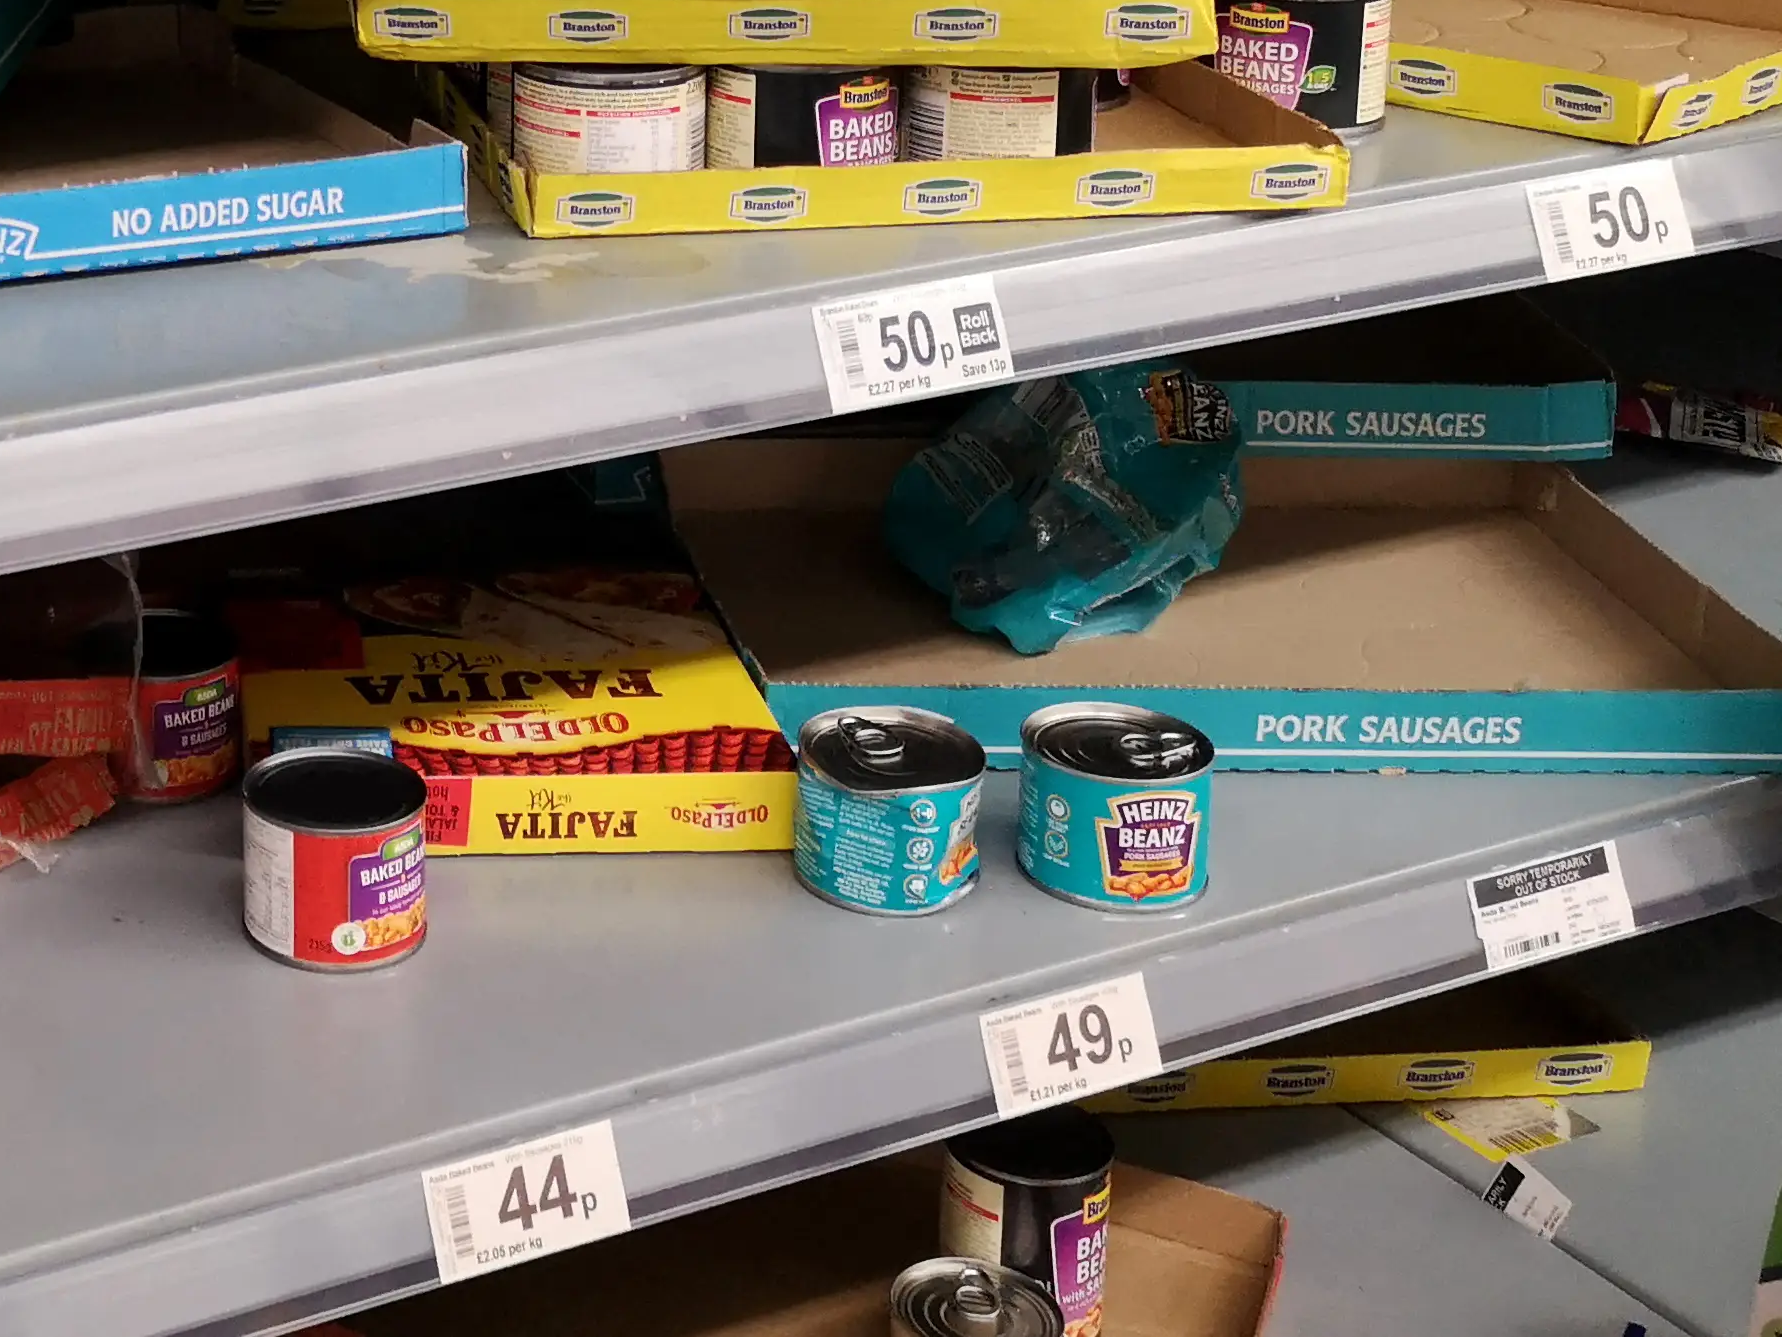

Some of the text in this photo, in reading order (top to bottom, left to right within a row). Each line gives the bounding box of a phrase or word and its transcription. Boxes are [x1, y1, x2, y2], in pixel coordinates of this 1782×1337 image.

[562, 20, 617, 35] Branston
[743, 17, 799, 33] Branston
[928, 17, 986, 34] Branston
[1119, 16, 1179, 33] Branston
[1233, 12, 1286, 30] Branston
[1220, 35, 1300, 62] BAKED
[1220, 55, 1296, 83] BEANS
[843, 86, 889, 105] Branston
[1232, 78, 1296, 96] AUSAGES
[1554, 95, 1604, 115] Branston
[829, 110, 894, 141] BAKED
[829, 134, 894, 163] BEANS
[1089, 181, 1144, 198] Branston
[1264, 174, 1318, 191] Branston
[569, 202, 623, 217] Branston
[743, 197, 796, 212] Branston
[917, 190, 970, 206] Branston
[111, 186, 346, 239] NO ADDED SUGAR
[1588, 184, 1670, 250] 50p
[960, 309, 991, 331] Roll
[879, 309, 955, 373] 50p
[960, 326, 998, 349] Back
[961, 361, 988, 378] Save
[868, 374, 932, 397] £2.27 per kg
[1255, 407, 1336, 440] PORK
[1344, 408, 1487, 440] SAUSAGES
[345, 667, 664, 706] FAJITA
[163, 708, 207, 731] BAKED
[1255, 714, 1523, 745] PORK SAUSAGES
[1122, 799, 1187, 824] HEINZ
[495, 809, 638, 841] FAJITA
[1118, 824, 1187, 848] BEANZ
[360, 858, 404, 887] BAKED
[1497, 852, 1594, 891] SORRY TEMPORARILY
[1515, 869, 1582, 897] OUT OF STOCK
[1047, 1003, 1134, 1073] 49p
[1266, 1073, 1328, 1092] Branston
[1405, 1068, 1467, 1085] Branston
[1544, 1063, 1607, 1080] Branston
[1029, 1076, 1088, 1102] £1.21 per kg
[498, 1152, 598, 1232] 44p
[476, 1235, 544, 1266] £2.05 per kg
